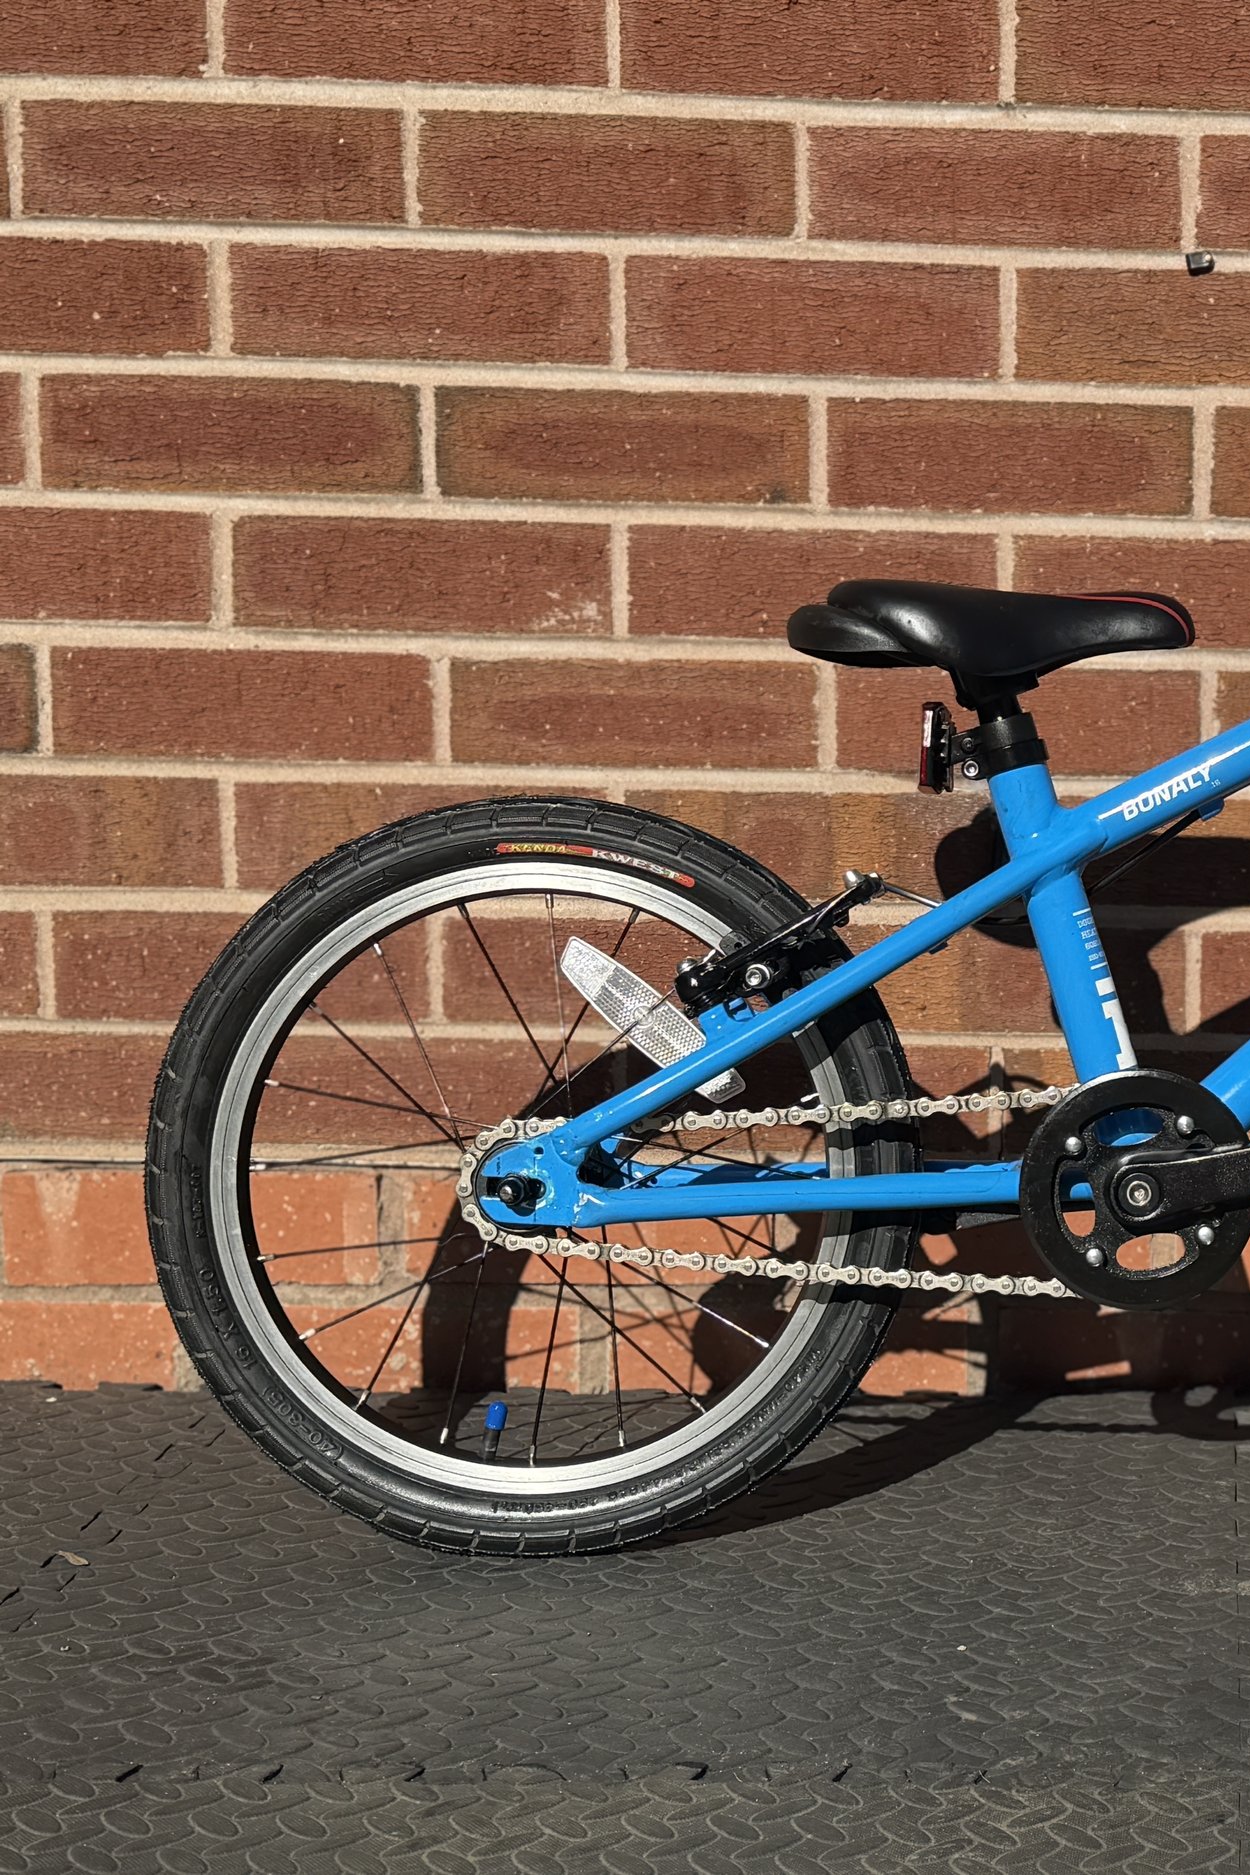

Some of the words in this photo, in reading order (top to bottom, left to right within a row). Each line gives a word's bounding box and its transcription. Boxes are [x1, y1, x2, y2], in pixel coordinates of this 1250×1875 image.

[1121, 763, 1211, 821] BONALY
[510, 842, 568, 855] KENDA
[592, 848, 681, 880] KWEST
